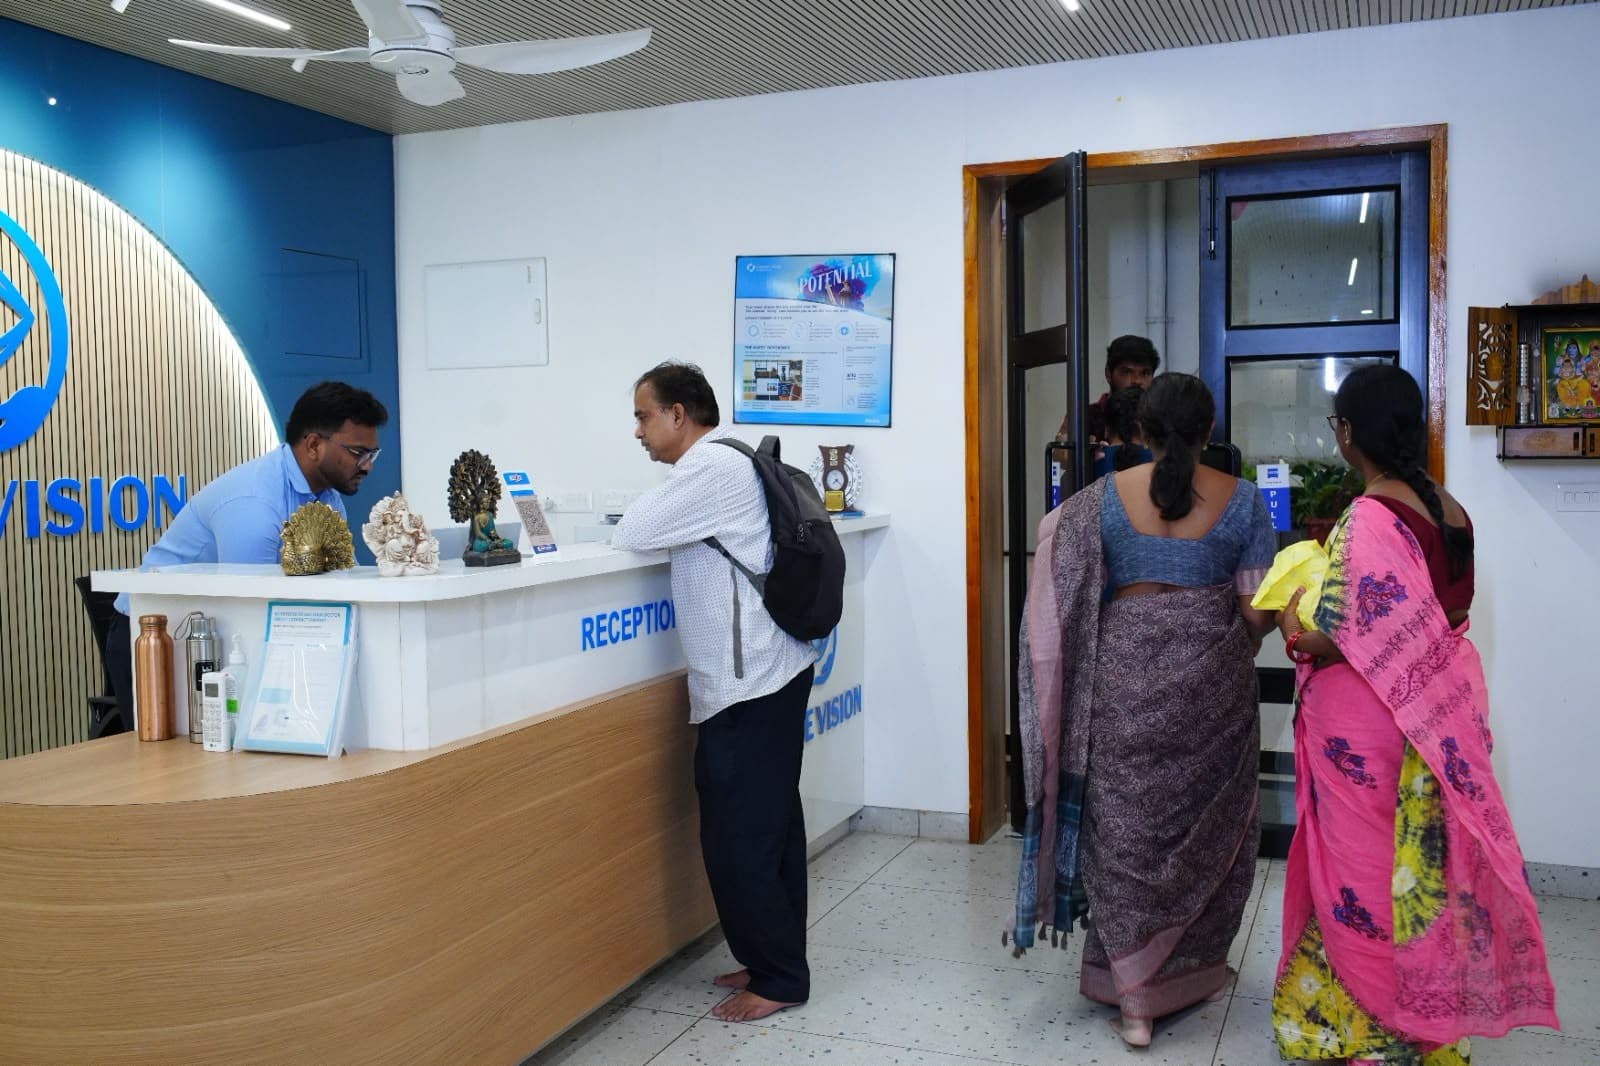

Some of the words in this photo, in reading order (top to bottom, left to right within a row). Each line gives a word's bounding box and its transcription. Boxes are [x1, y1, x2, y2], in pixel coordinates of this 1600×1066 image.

[800, 261, 873, 293] POTENTIAL
[1269, 490, 1278, 529] PULL
[815, 684, 862, 735] VISION
